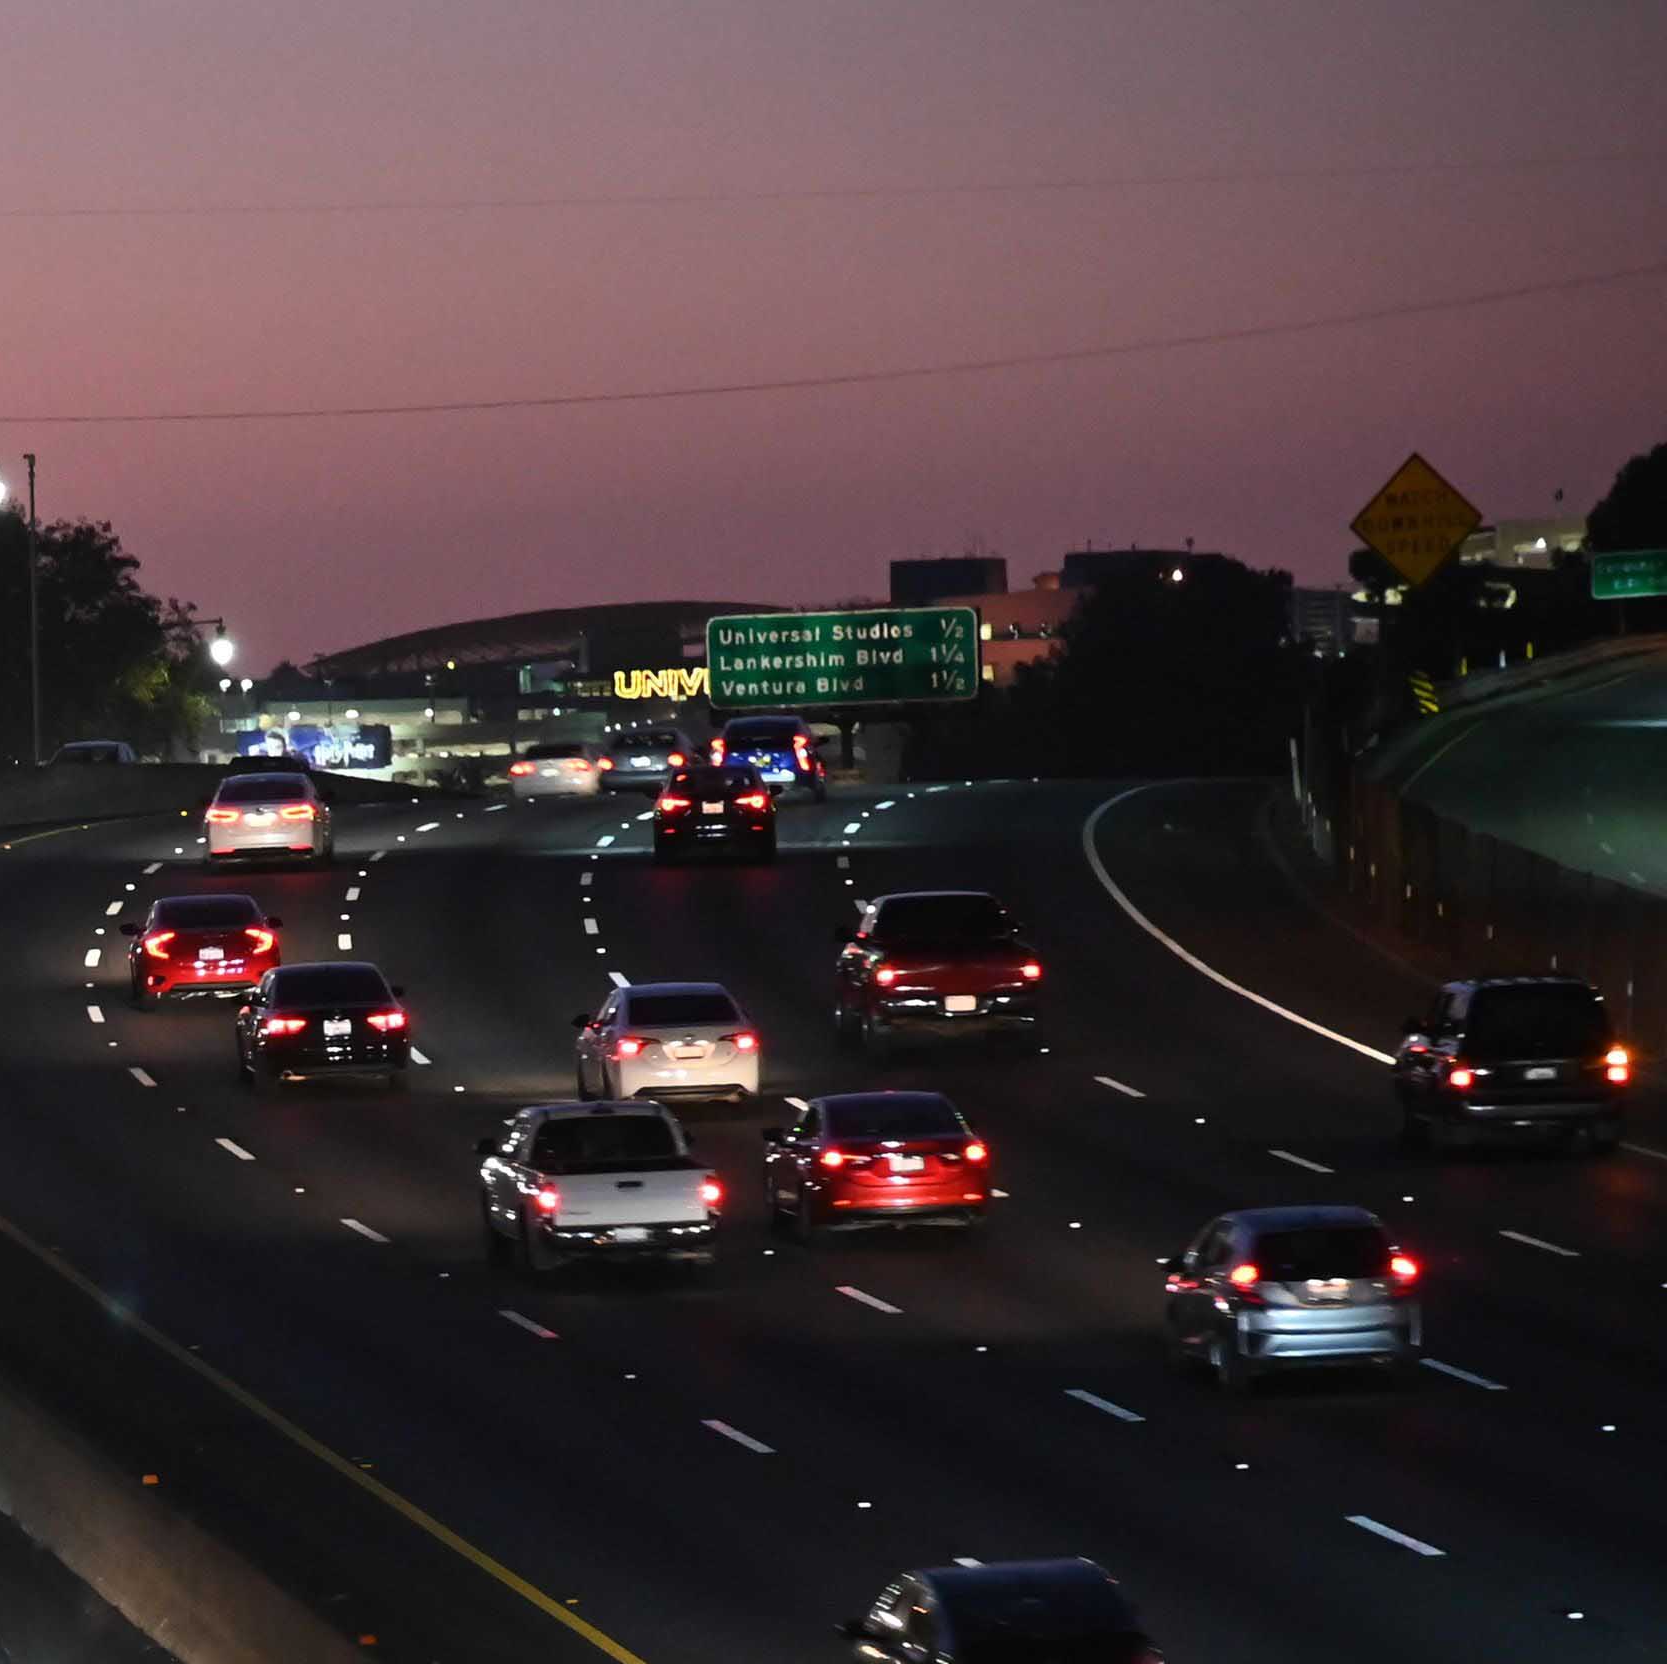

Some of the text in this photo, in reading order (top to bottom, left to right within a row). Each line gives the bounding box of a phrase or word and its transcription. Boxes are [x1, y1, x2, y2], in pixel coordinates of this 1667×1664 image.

[719, 626, 821, 645] Universal
[832, 622, 913, 641] Studios
[720, 652, 846, 671] Lankershim
[856, 648, 904, 665] Blvd
[721, 677, 806, 696] Ventura
[816, 675, 866, 692] Blvd
